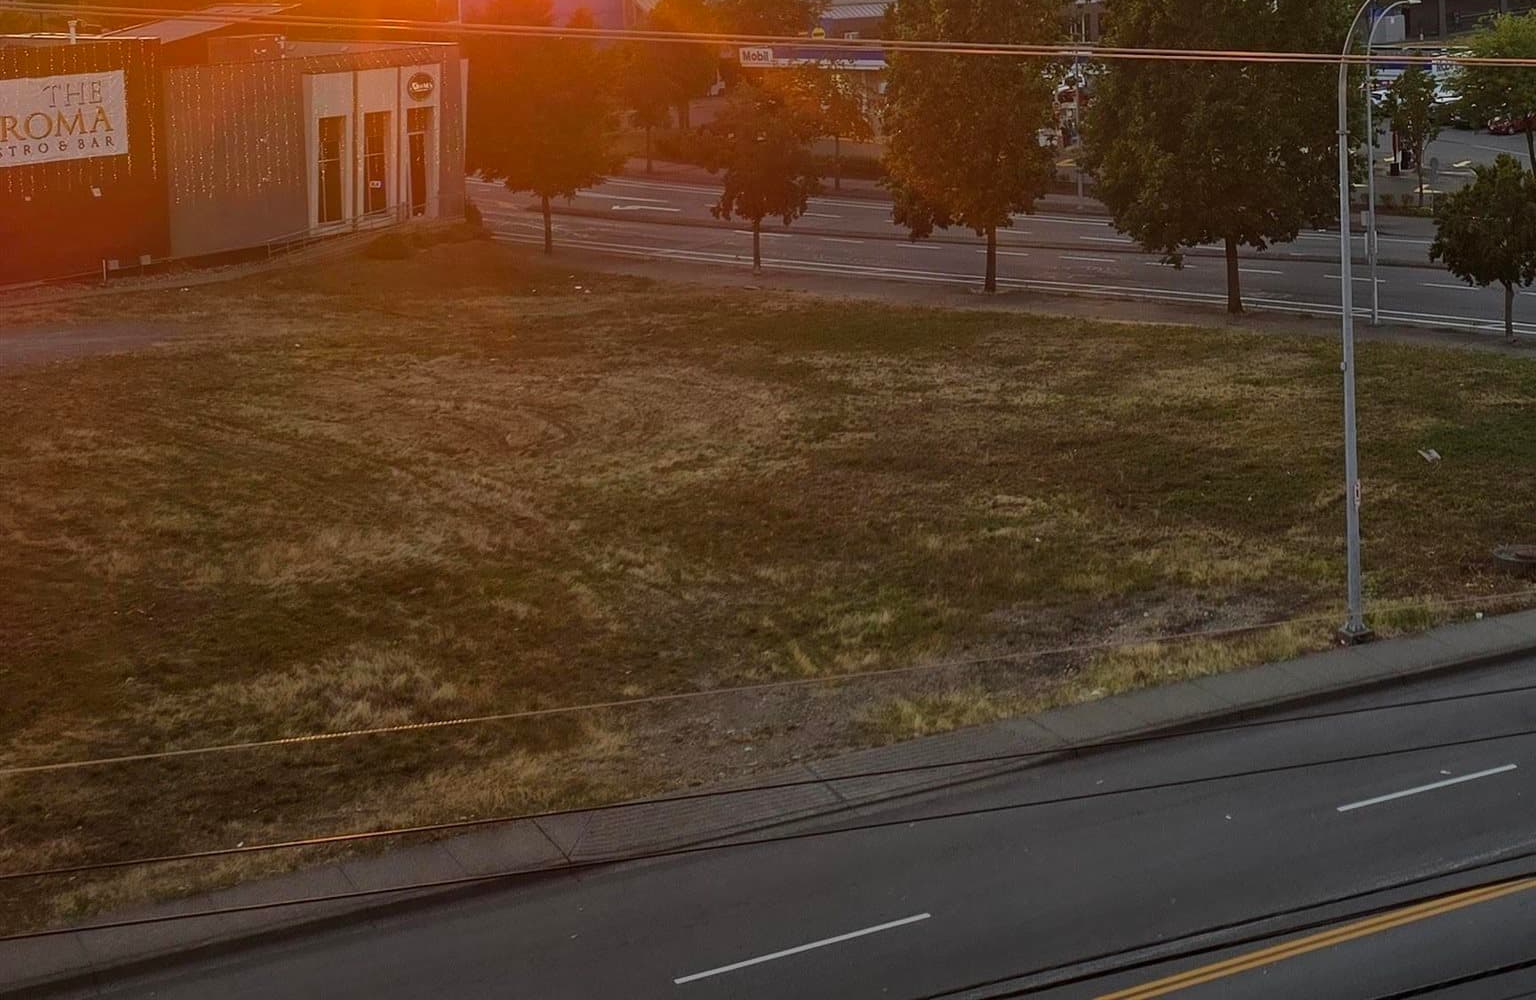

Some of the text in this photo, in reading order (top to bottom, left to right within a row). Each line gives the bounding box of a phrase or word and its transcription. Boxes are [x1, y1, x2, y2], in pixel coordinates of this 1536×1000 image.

[742, 50, 769, 62] Mobil
[42, 80, 102, 108] THE
[58, 140, 68, 152] &
[78, 136, 115, 150] BAR
